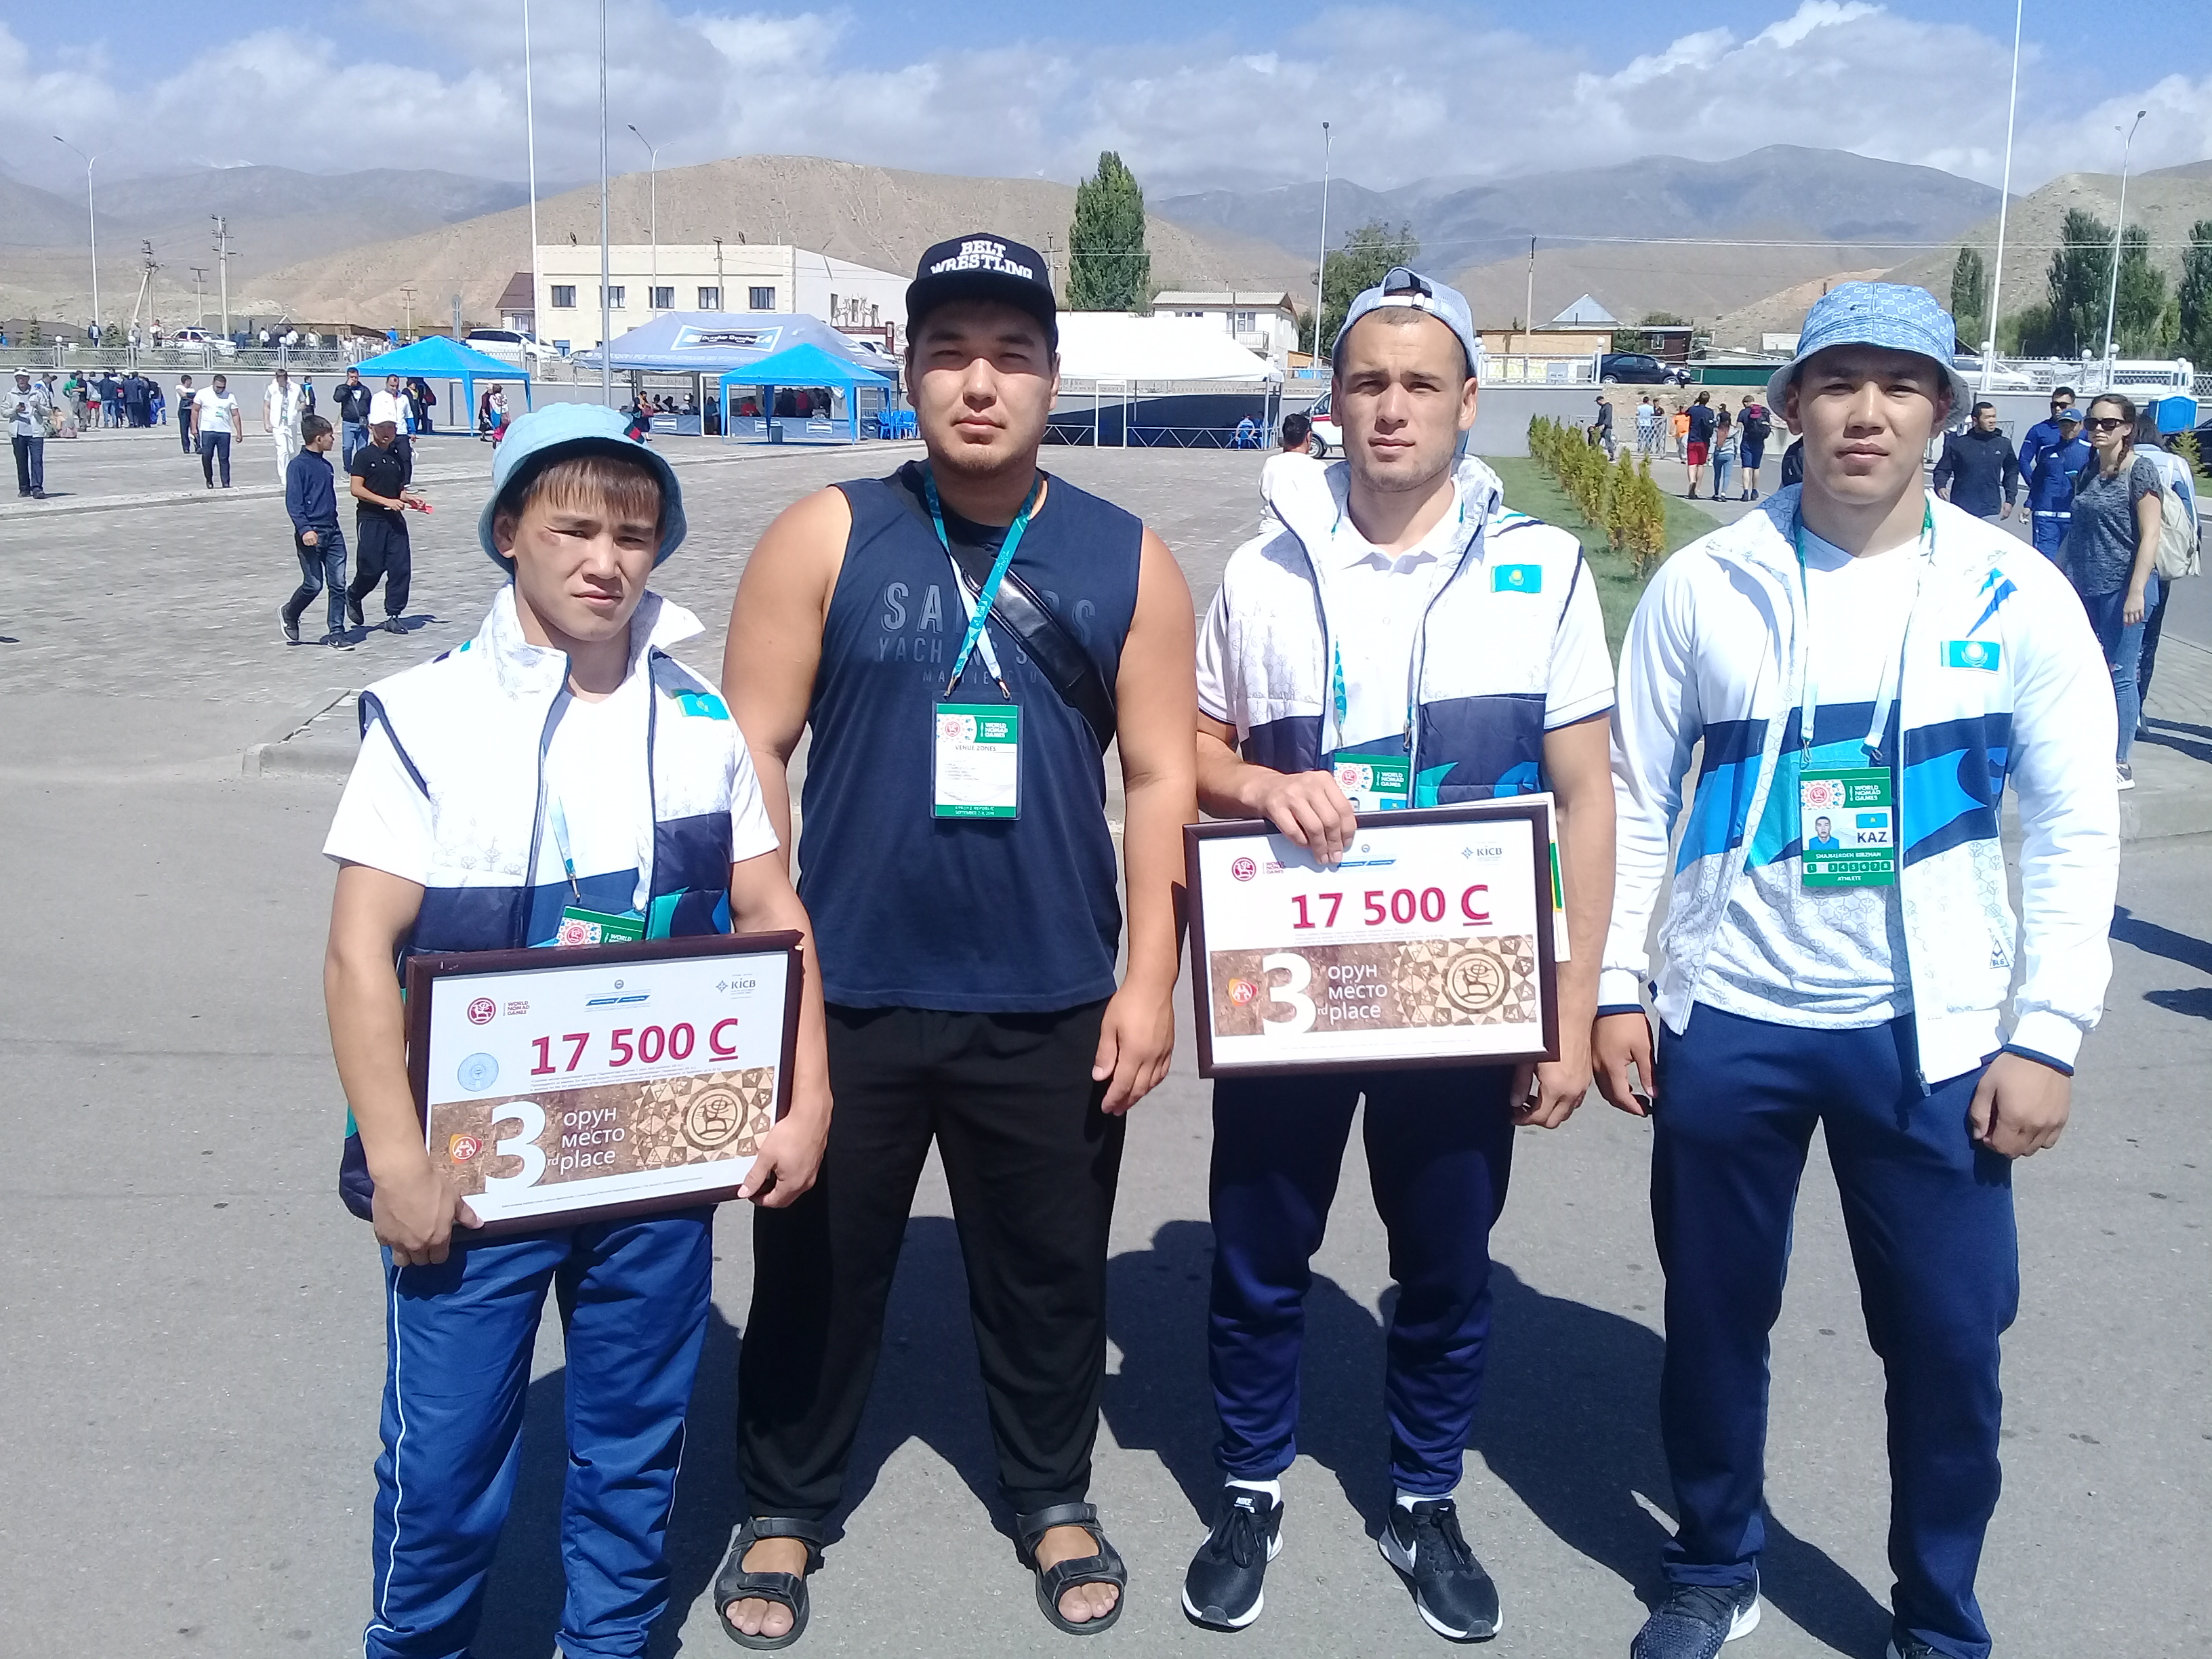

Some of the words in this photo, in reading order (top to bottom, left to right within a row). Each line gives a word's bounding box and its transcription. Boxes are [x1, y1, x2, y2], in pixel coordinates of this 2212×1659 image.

[960, 240, 1006, 257] BELT
[930, 254, 1033, 280] WRESTLING
[1857, 832, 1887, 844] KAZ
[1291, 892, 1343, 929] 17
[1364, 887, 1446, 926] 500
[610, 933, 632, 941] WORLD
[1328, 964, 1377, 984] орун
[1262, 952, 1317, 1036] 3
[1328, 983, 1388, 1000] место
[1329, 1002, 1381, 1025] place
[531, 1032, 590, 1076] 17
[609, 1022, 695, 1067] 500
[563, 1107, 617, 1131] орун
[485, 1100, 548, 1195] 3
[561, 1128, 626, 1149] место
[560, 1149, 615, 1176] place
